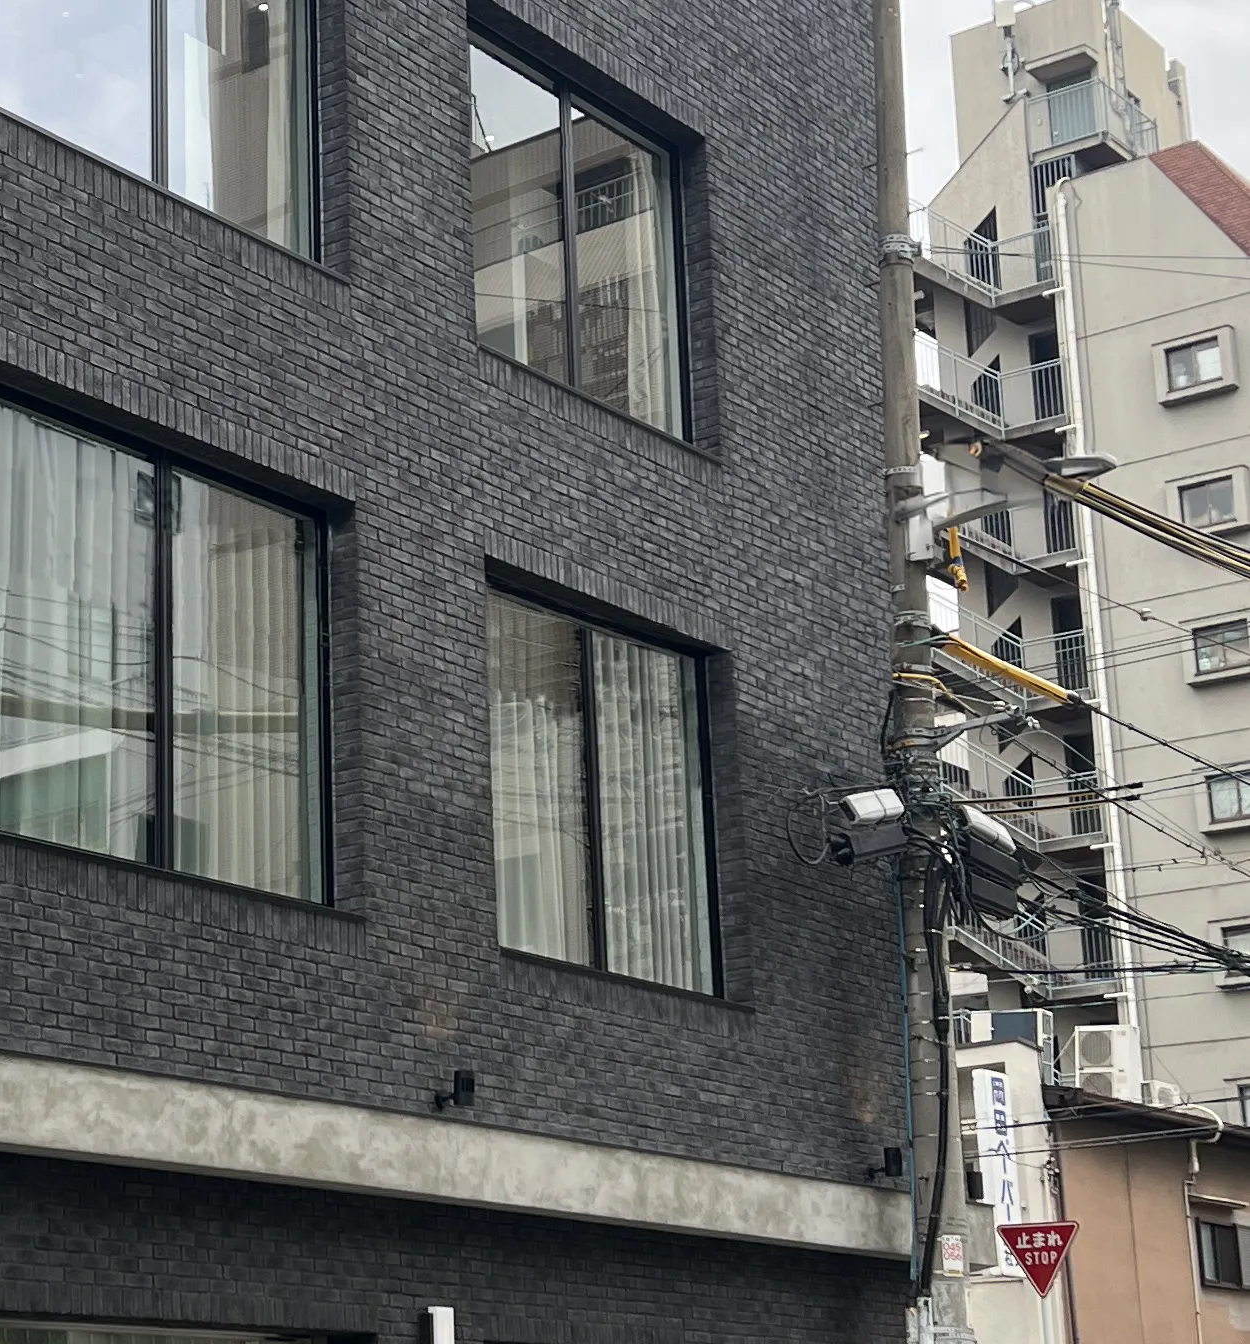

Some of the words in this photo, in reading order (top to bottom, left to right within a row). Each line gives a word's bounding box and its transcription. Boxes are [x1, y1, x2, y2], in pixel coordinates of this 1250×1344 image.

[1015, 1230, 1063, 1249] 止まれ
[1024, 1250, 1058, 1265] STOP
